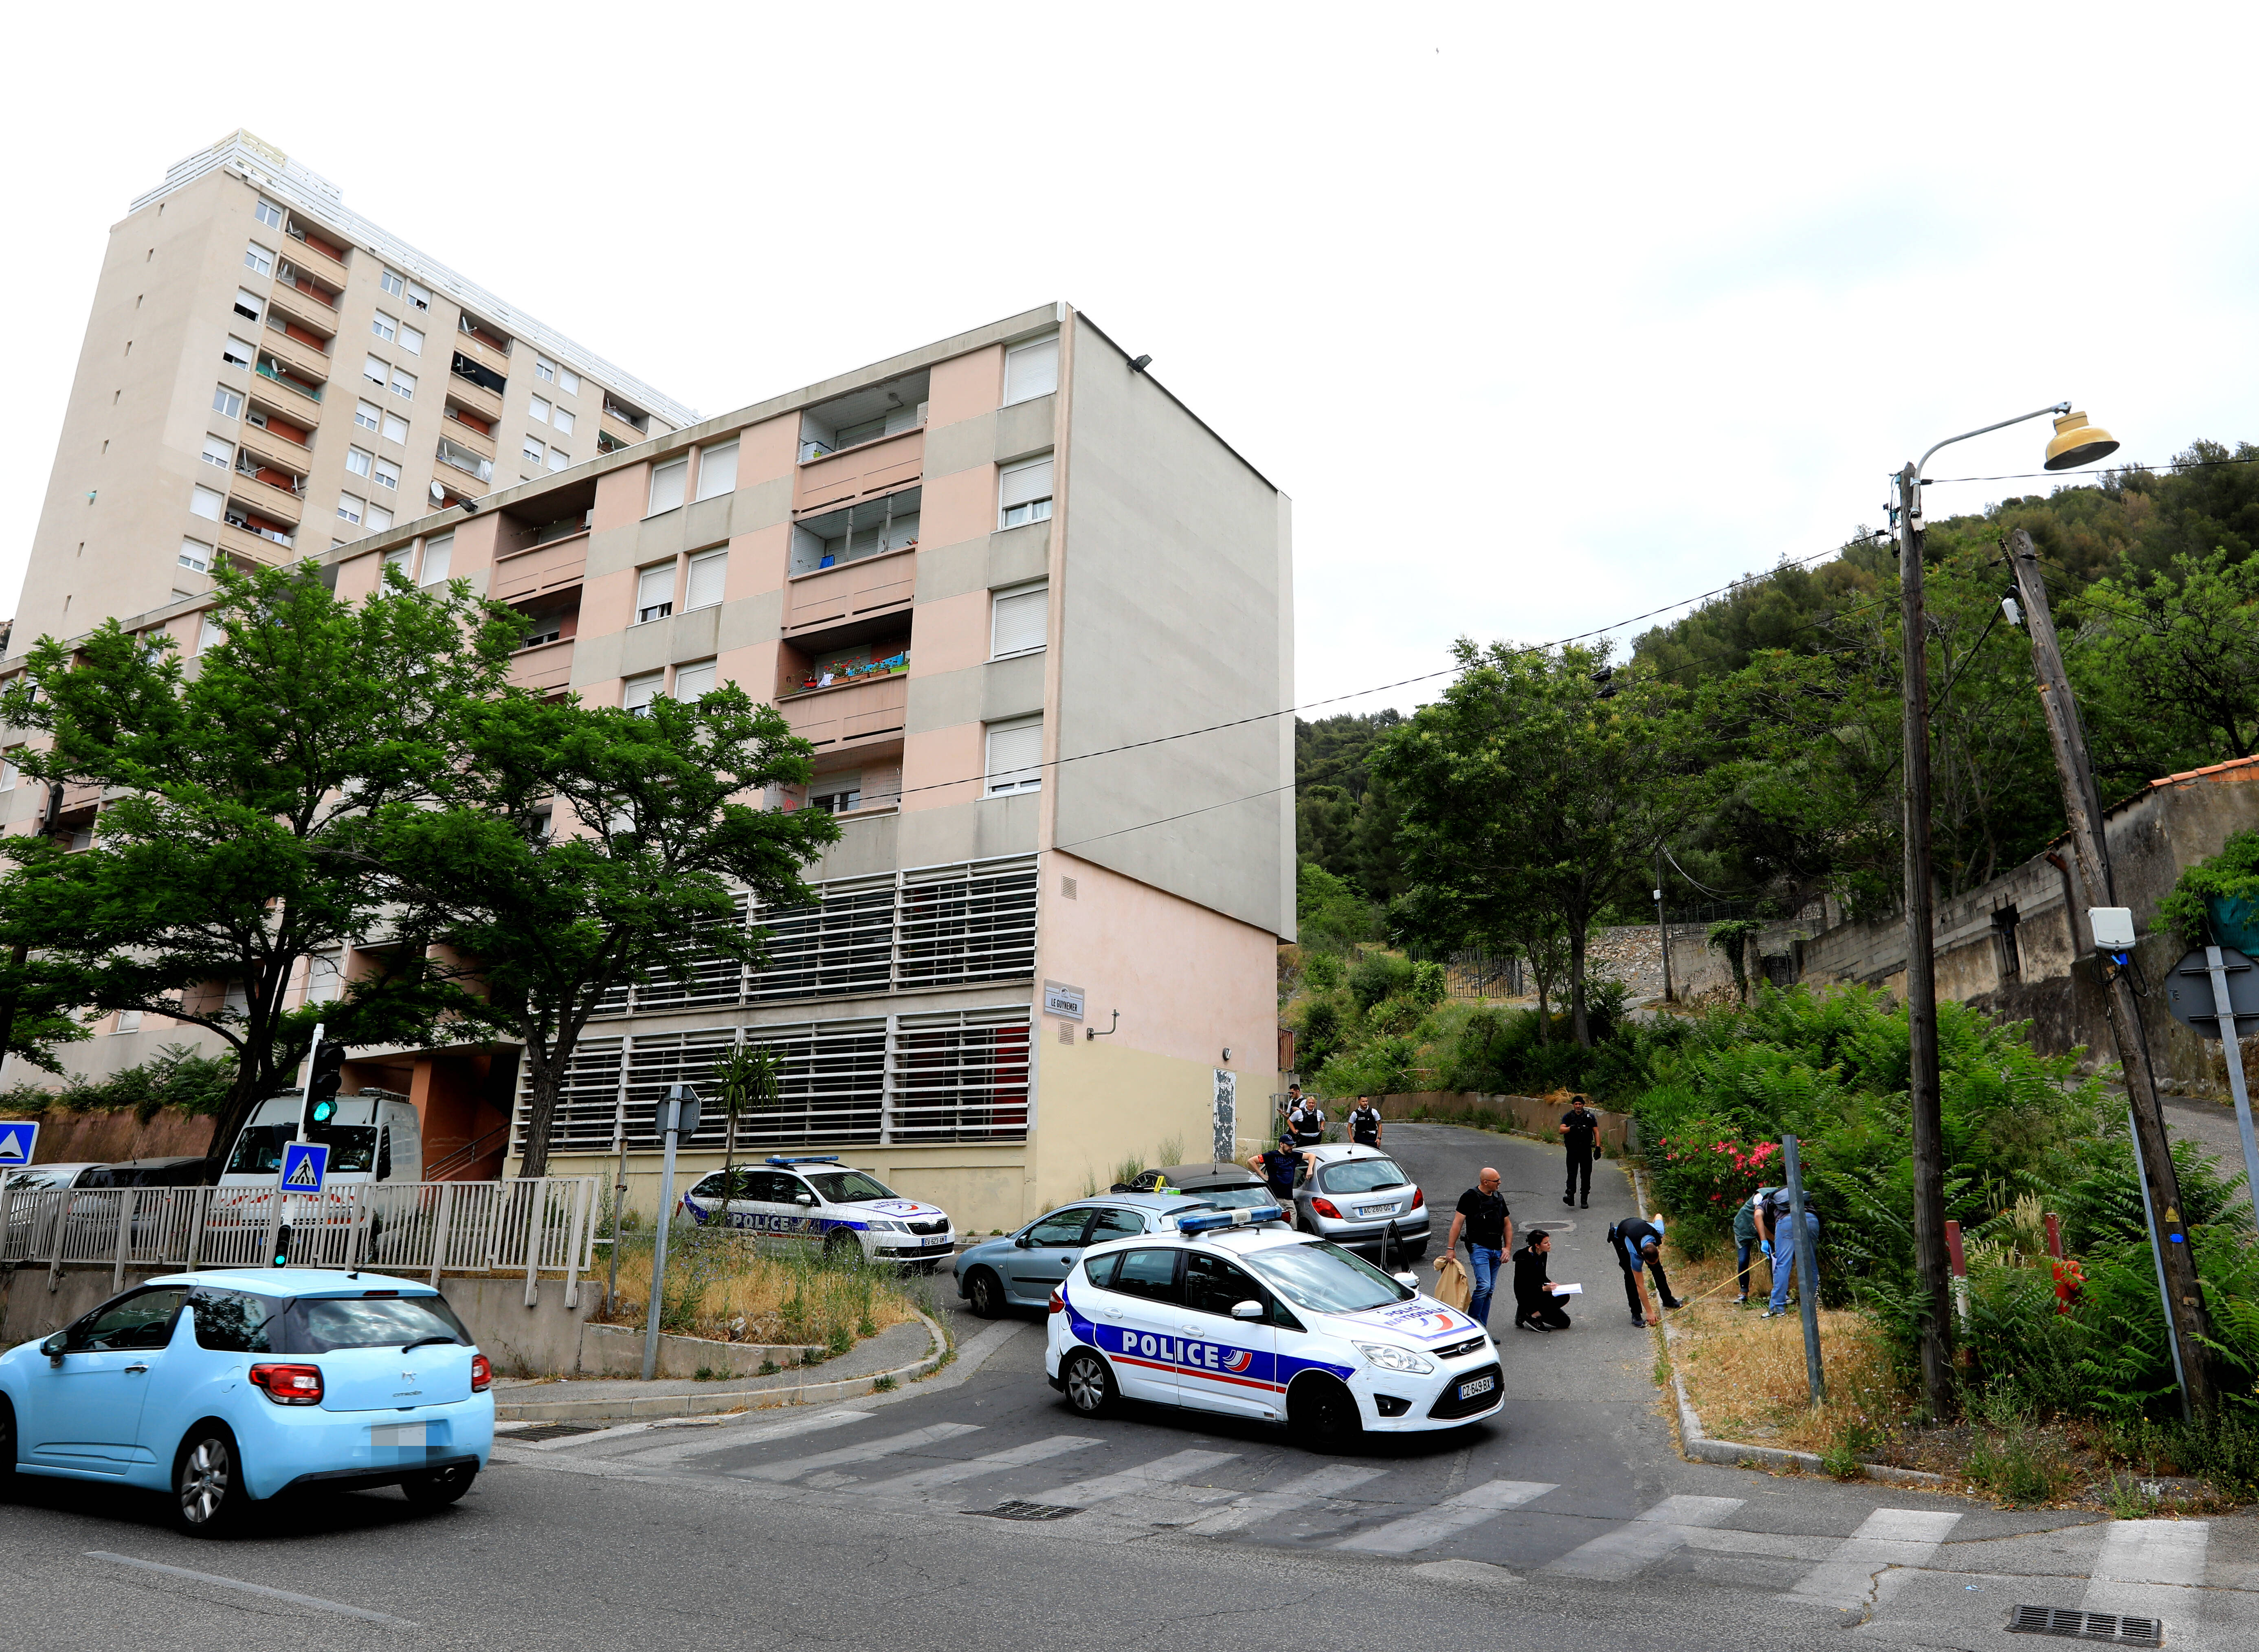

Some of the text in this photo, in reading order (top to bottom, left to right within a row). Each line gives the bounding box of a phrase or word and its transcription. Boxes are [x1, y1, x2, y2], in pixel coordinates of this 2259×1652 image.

[1051, 998, 1077, 1012] LE GUYNEMER
[732, 1214, 789, 1230] POLICE
[1384, 1306, 1425, 1317] POLICE
[1384, 1308, 1449, 1326] NATIONALE
[1123, 1331, 1219, 1369] POLICE
[1462, 1378, 1490, 1397] CZ-649-BX
